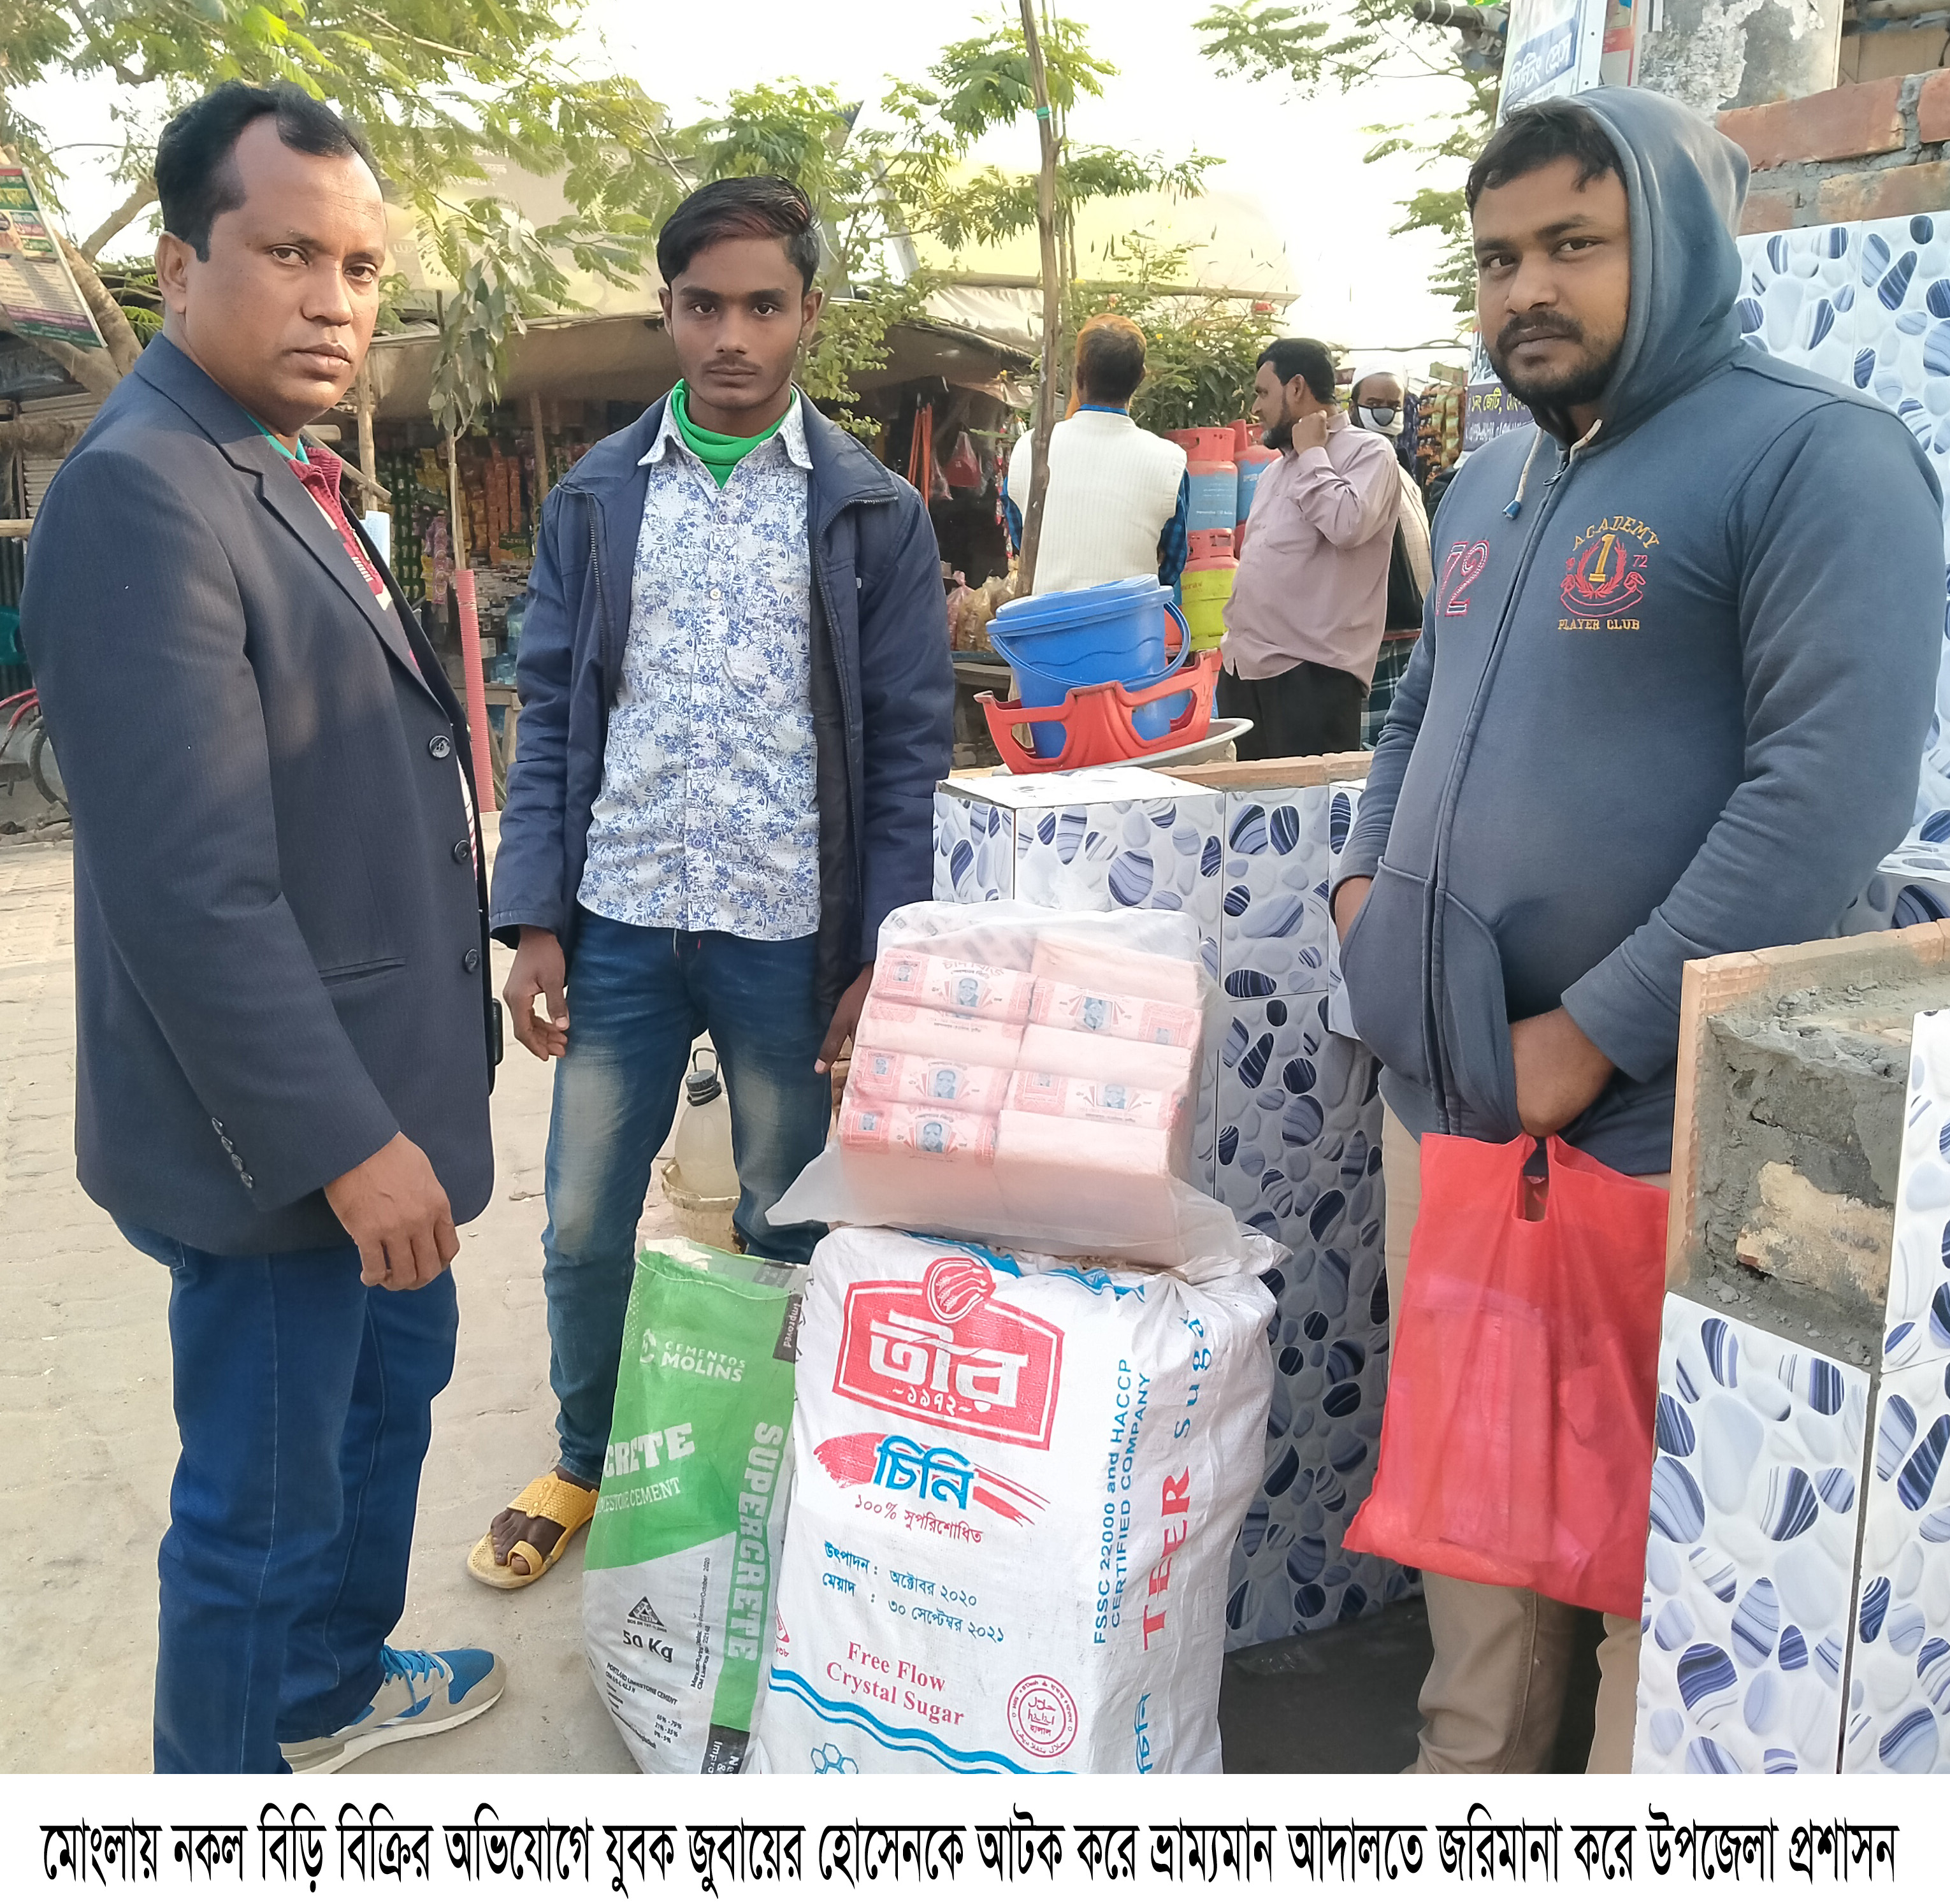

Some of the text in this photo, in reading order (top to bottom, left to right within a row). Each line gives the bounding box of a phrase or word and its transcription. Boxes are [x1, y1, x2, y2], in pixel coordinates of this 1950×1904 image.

[1572, 516, 1659, 551] ACADEMY
[1436, 540, 1489, 617] 72
[1633, 554, 1648, 568] 72
[1557, 619, 1640, 630] PLAYER CLUB
[783, 1303, 801, 1348] Improved
[660, 1351, 743, 1382] MOLINS
[665, 1341, 746, 1369] CEMENTOS
[869, 1308, 1029, 1413] তীর
[630, 1476, 681, 1507] CEMENT
[873, 1434, 976, 1511] চিনি
[1143, 1317, 1211, 1650] TEER Suga
[855, 1494, 984, 1544] ১০০% সুপরিশোধিত
[1094, 1359, 1132, 1644] FSSC 22000 and HACCP
[1111, 1372, 1151, 1629] CERTIFIED COMPANY
[728, 1422, 784, 1661] SUPERCRETE
[822, 1572, 856, 1597] মেয়াদ
[887, 1599, 906, 1616] ৩০
[911, 1606, 964, 1633] সেপ্টেম্বর
[967, 1621, 1005, 1643] ২০২১
[889, 1569, 936, 1596] অক্টোবর
[939, 1584, 978, 1608] ২০২০
[623, 1629, 674, 1663] 50 Kg
[848, 1641, 946, 1692] Free Flow
[606, 1662, 628, 1682] PORTLAND
[656, 1691, 678, 1706] CEMENT
[827, 1661, 965, 1726] Crystal Sugar
[707, 1740, 723, 1774] Impro
[717, 1763, 726, 1771] &
[727, 1756, 740, 1774] Ne
